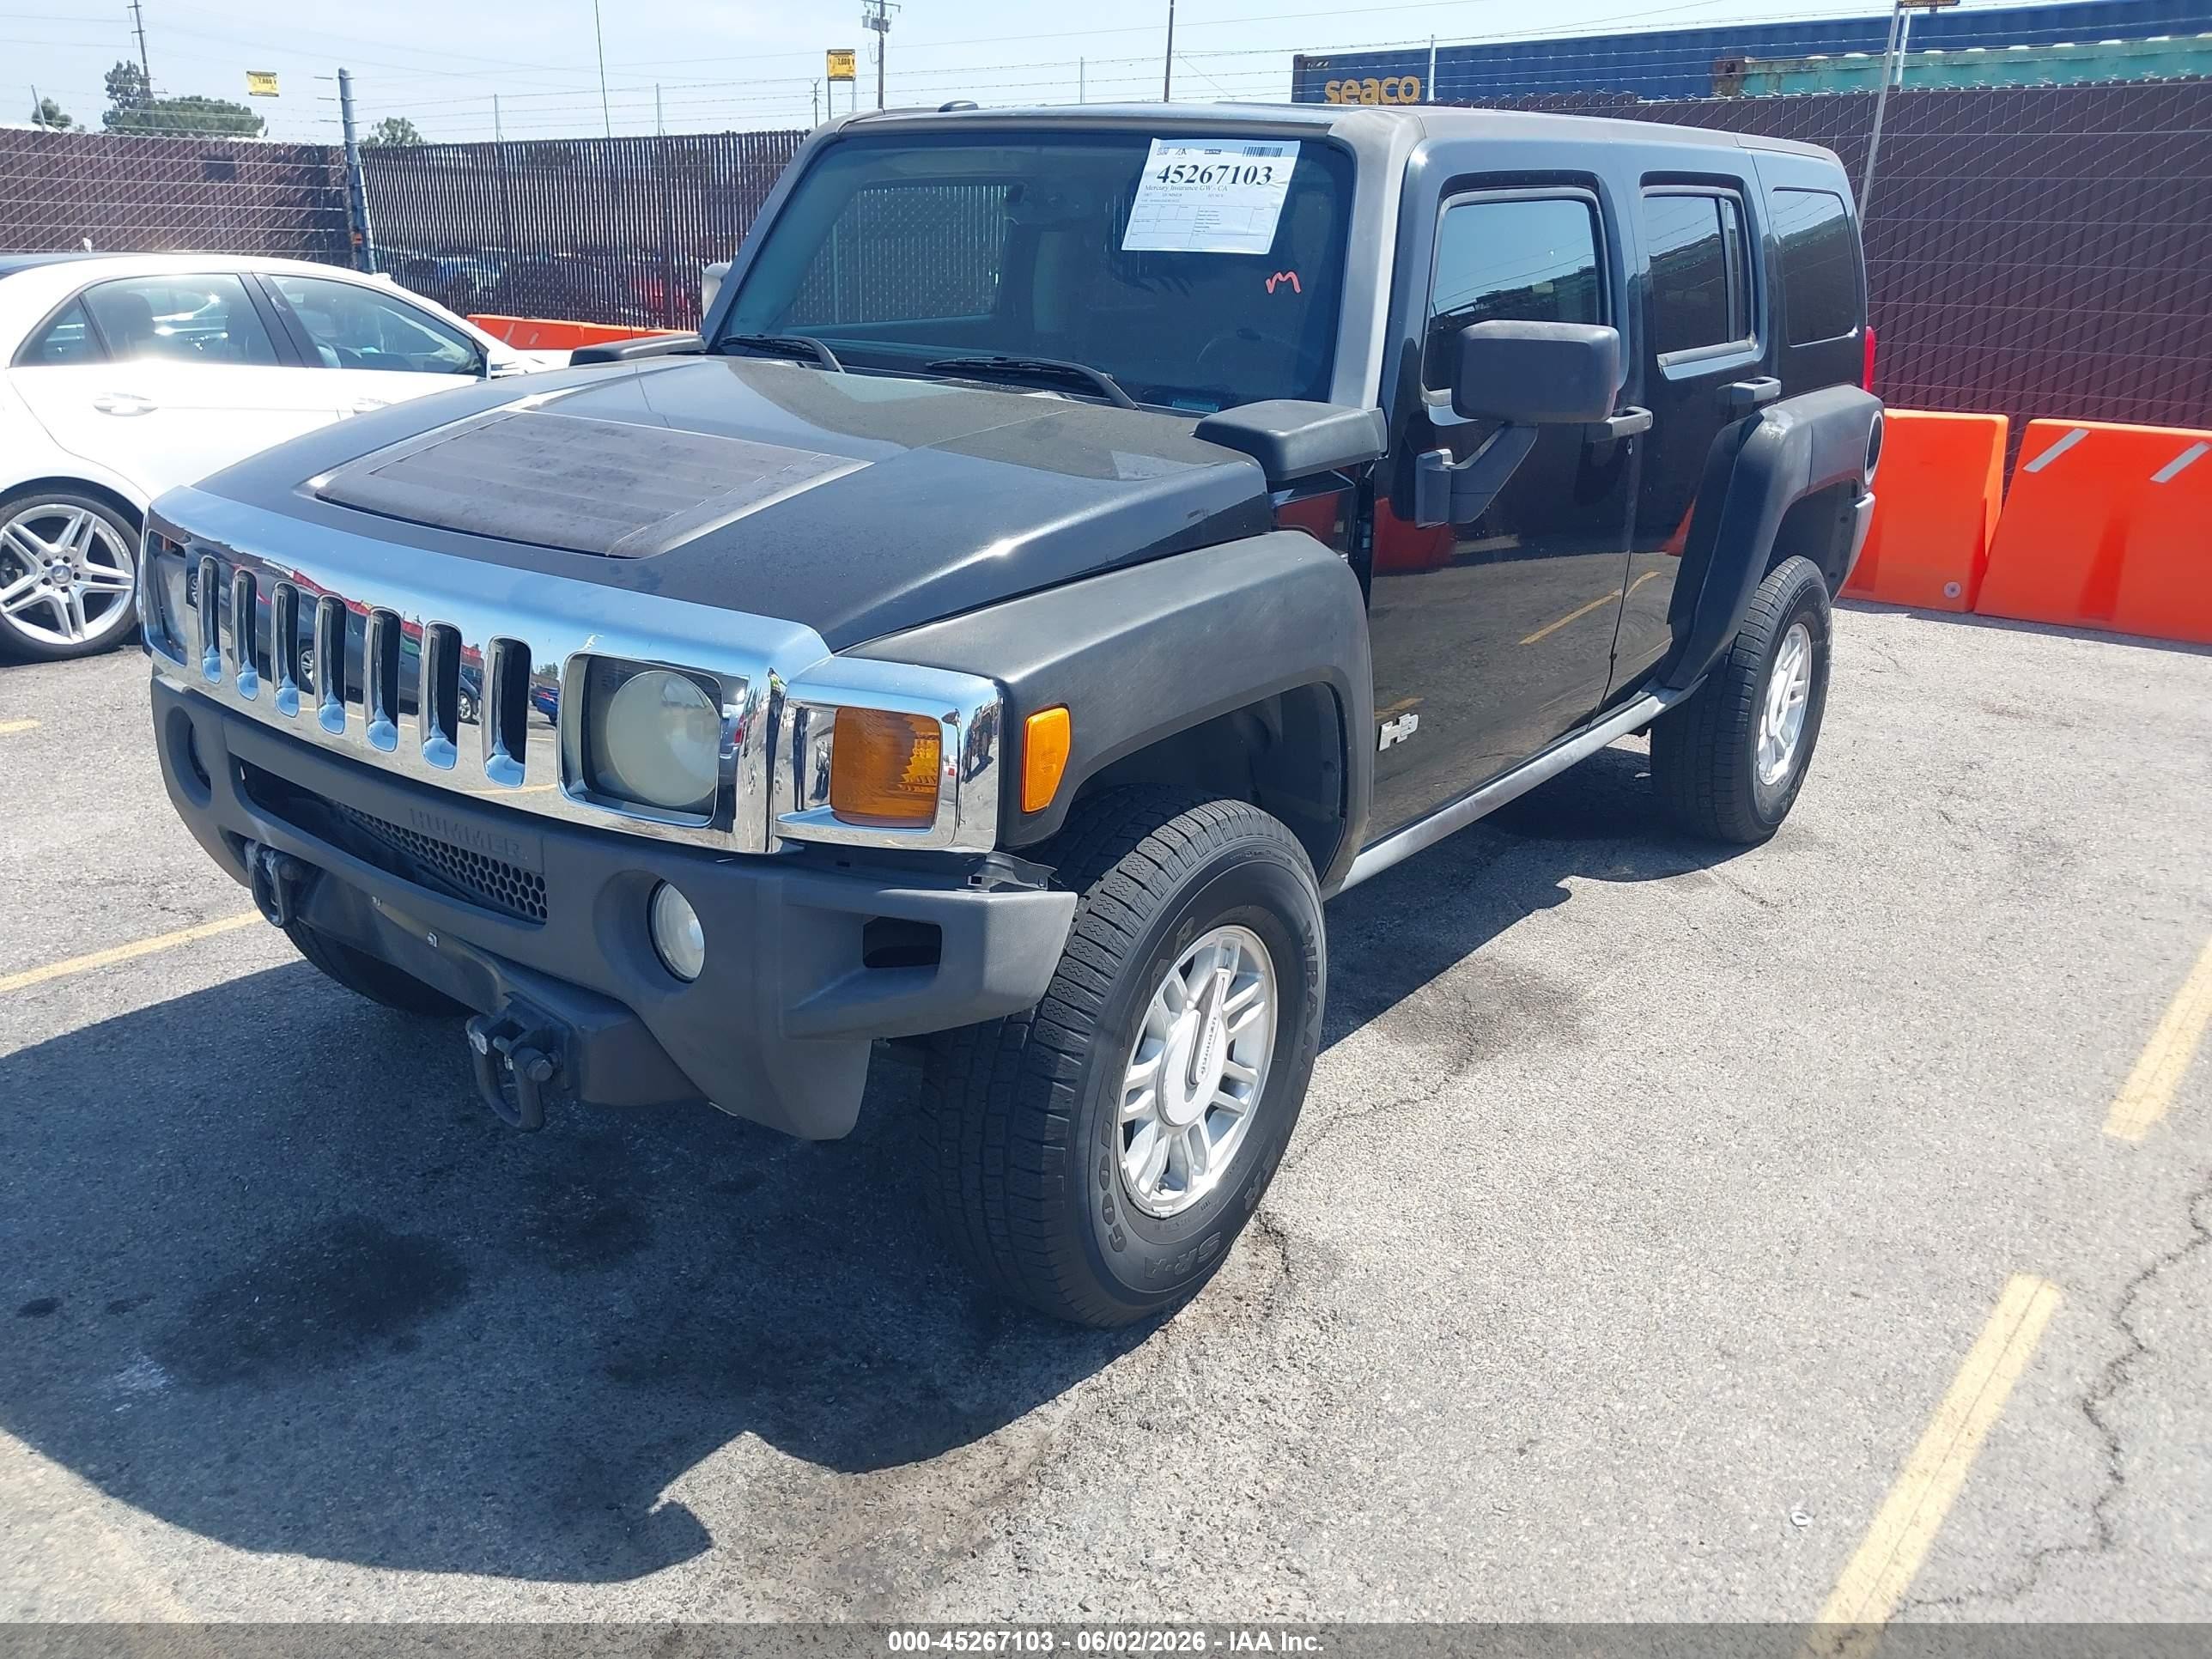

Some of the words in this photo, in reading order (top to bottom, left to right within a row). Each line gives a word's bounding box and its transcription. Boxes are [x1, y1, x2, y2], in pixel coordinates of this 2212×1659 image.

[1324, 76, 1421, 105] seaco
[1157, 164, 1273, 185] 45267103
[410, 808, 521, 858] HUMMER
